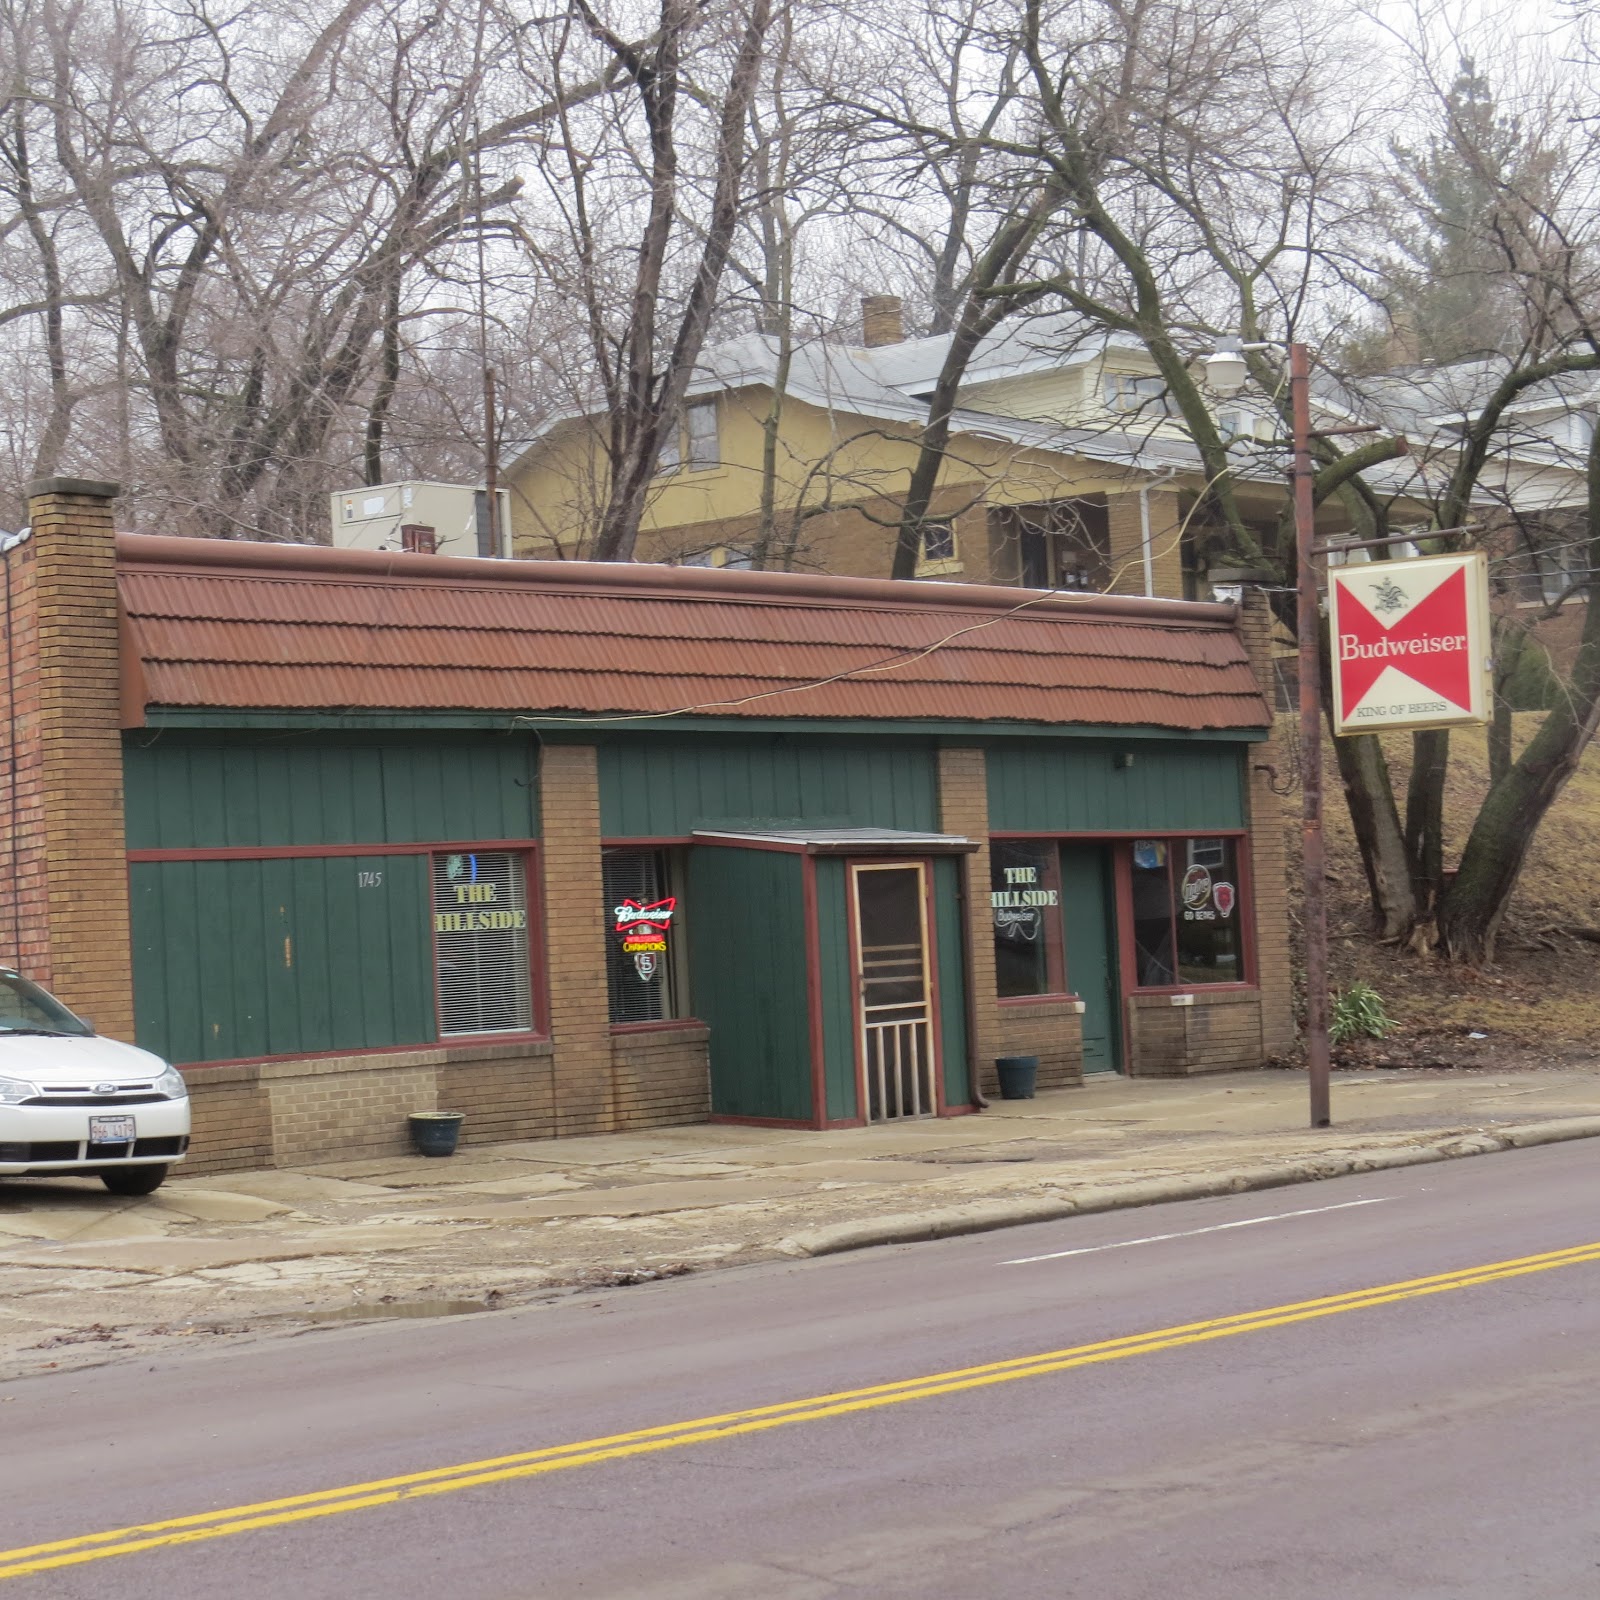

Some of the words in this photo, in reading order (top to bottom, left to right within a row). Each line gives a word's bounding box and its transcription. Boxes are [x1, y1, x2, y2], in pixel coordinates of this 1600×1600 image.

[1340, 633, 1466, 661] Budweiser
[1356, 706, 1387, 718] KING
[1390, 704, 1405, 715] OF
[1408, 701, 1448, 713] BEERS
[358, 871, 382, 888] 1745
[1004, 867, 1037, 884] THE
[454, 883, 498, 903] THE
[614, 906, 673, 922] Budweiser
[998, 908, 1035, 922] Budweiser
[1184, 911, 1195, 921] GO
[1195, 911, 1216, 921] BEARS
